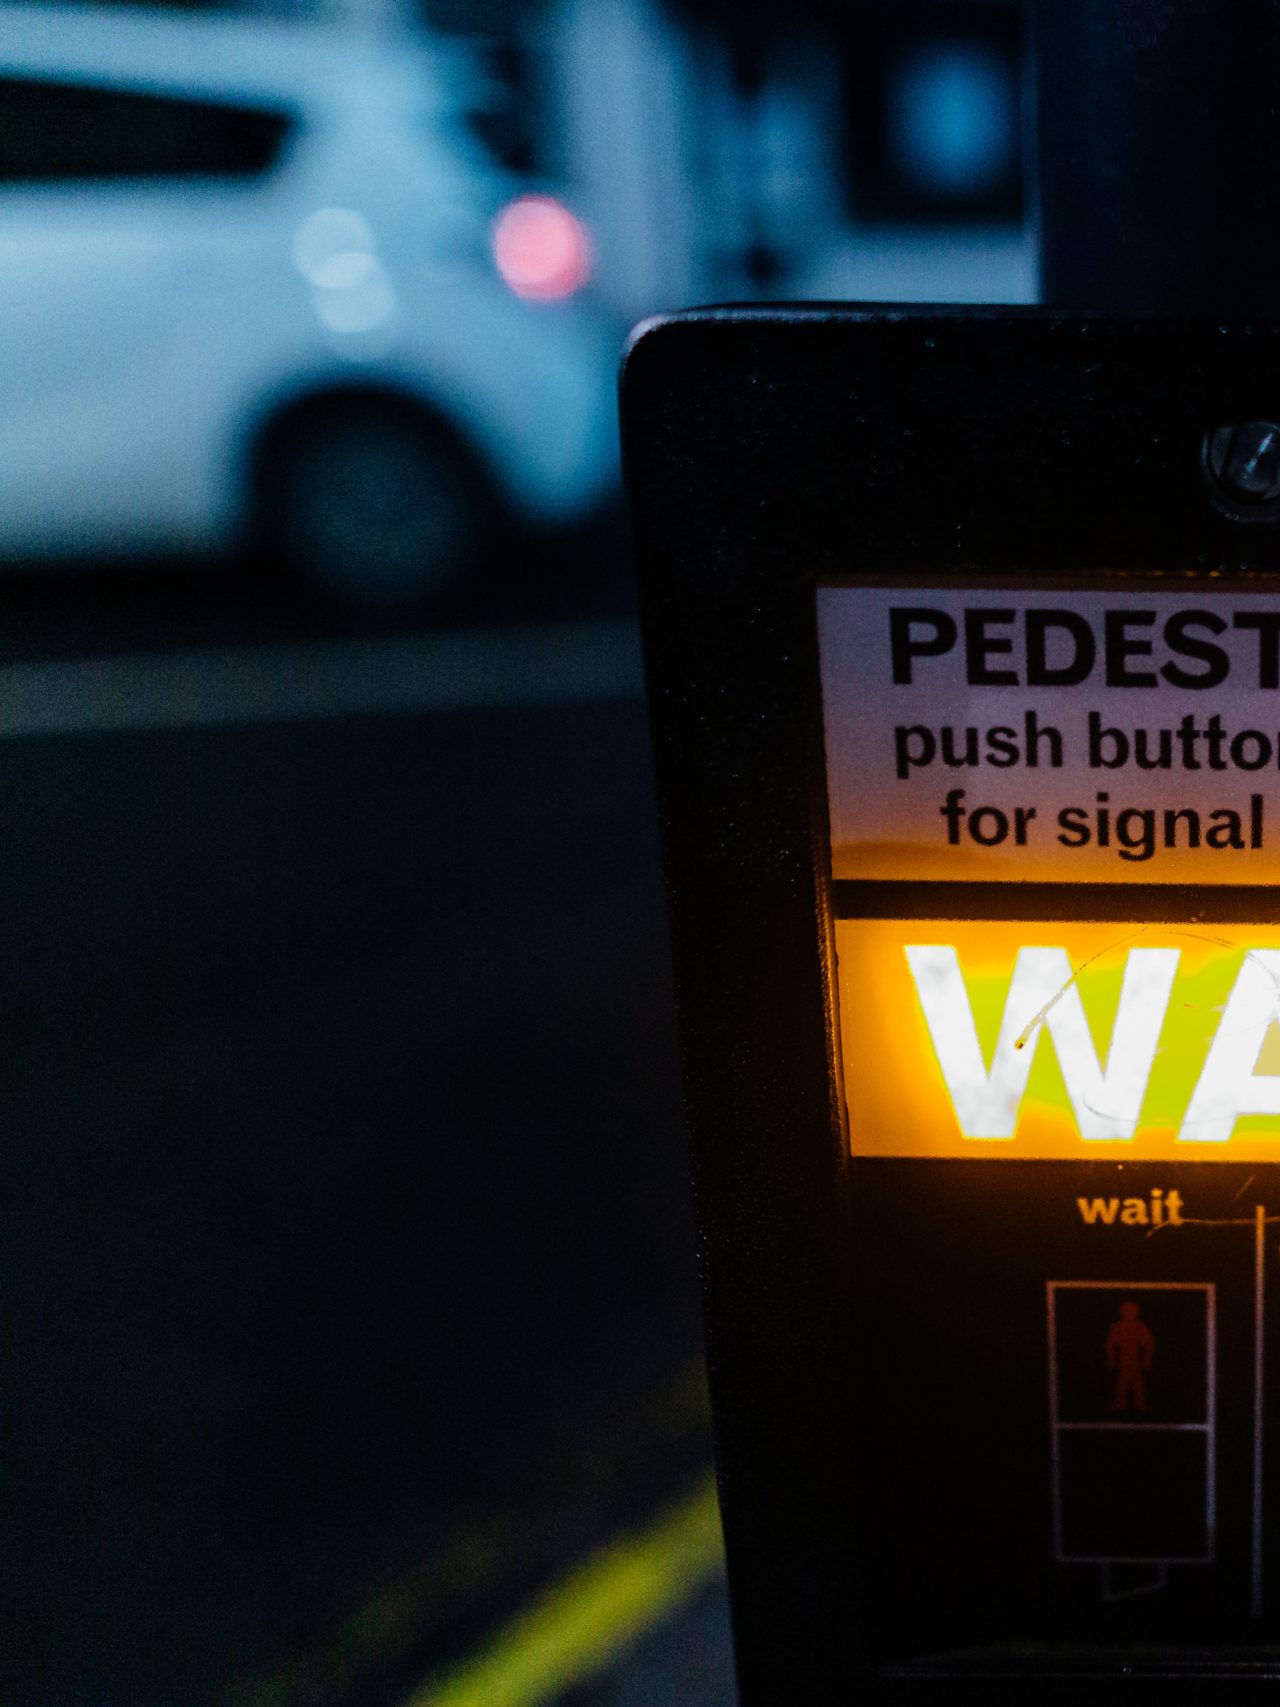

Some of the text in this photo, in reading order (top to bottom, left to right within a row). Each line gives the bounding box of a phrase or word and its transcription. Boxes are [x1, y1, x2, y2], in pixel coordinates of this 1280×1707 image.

[894, 711, 1064, 779] push
[940, 789, 1037, 847] for
[1056, 792, 1264, 862] signal
[1077, 1187, 1185, 1225] wait
